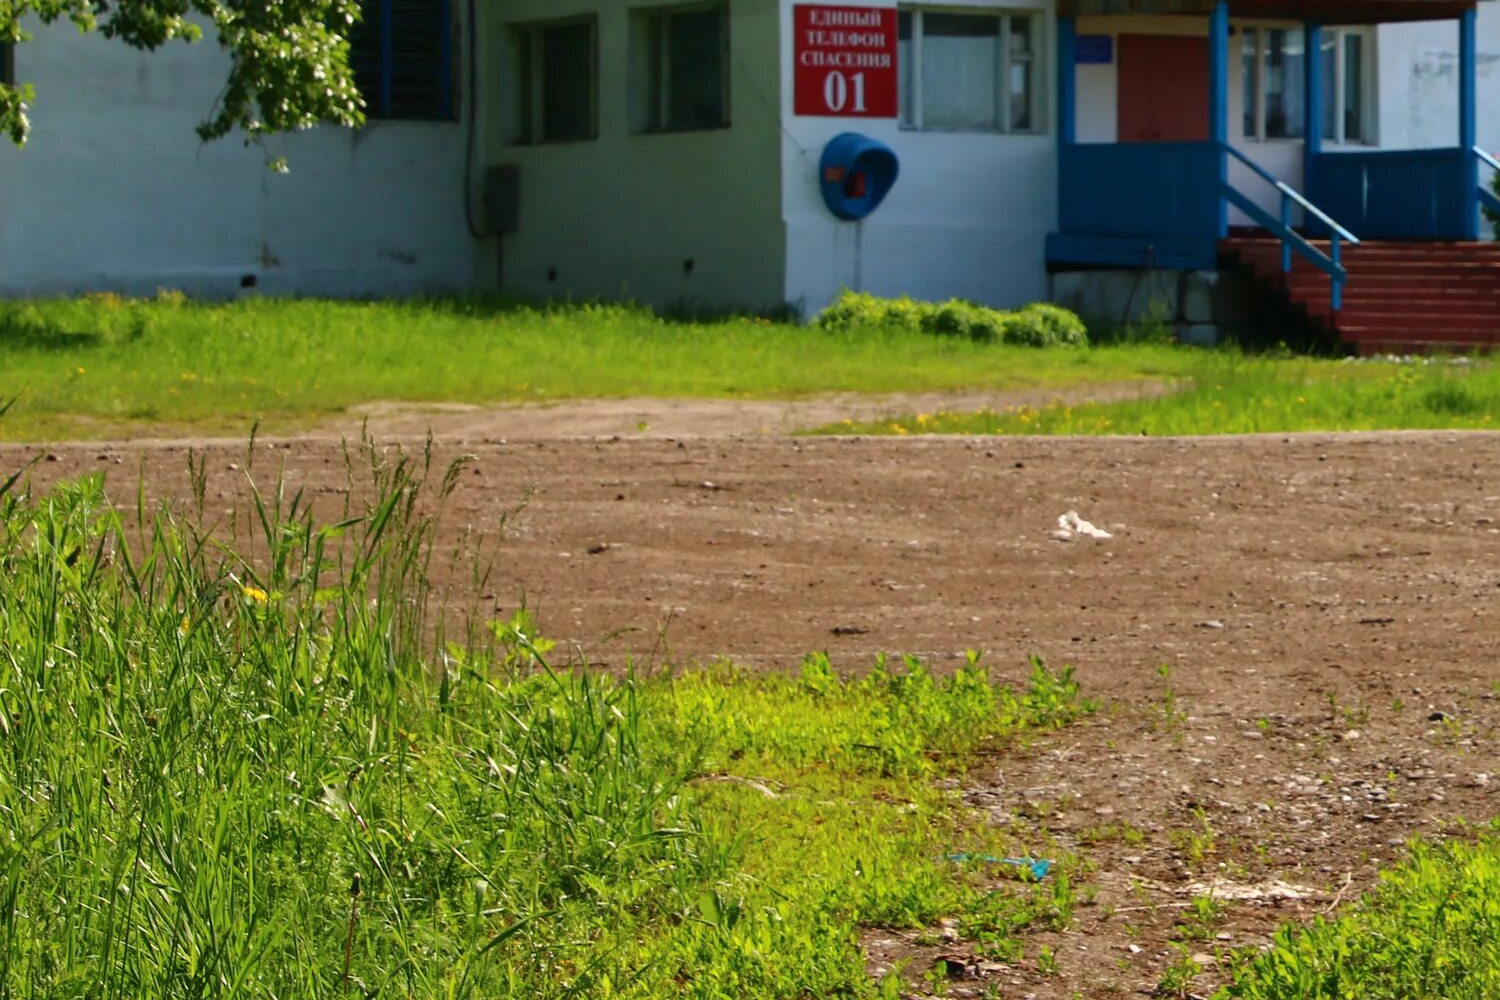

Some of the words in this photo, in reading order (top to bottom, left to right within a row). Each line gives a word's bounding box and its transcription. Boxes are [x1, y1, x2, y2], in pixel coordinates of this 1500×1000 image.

[809, 9, 882, 26] ЕДИНЫЙ
[806, 30, 886, 48] ТЕЛЕФОН
[800, 50, 891, 68] СПАСЕНИЯ
[824, 70, 867, 112] 01
